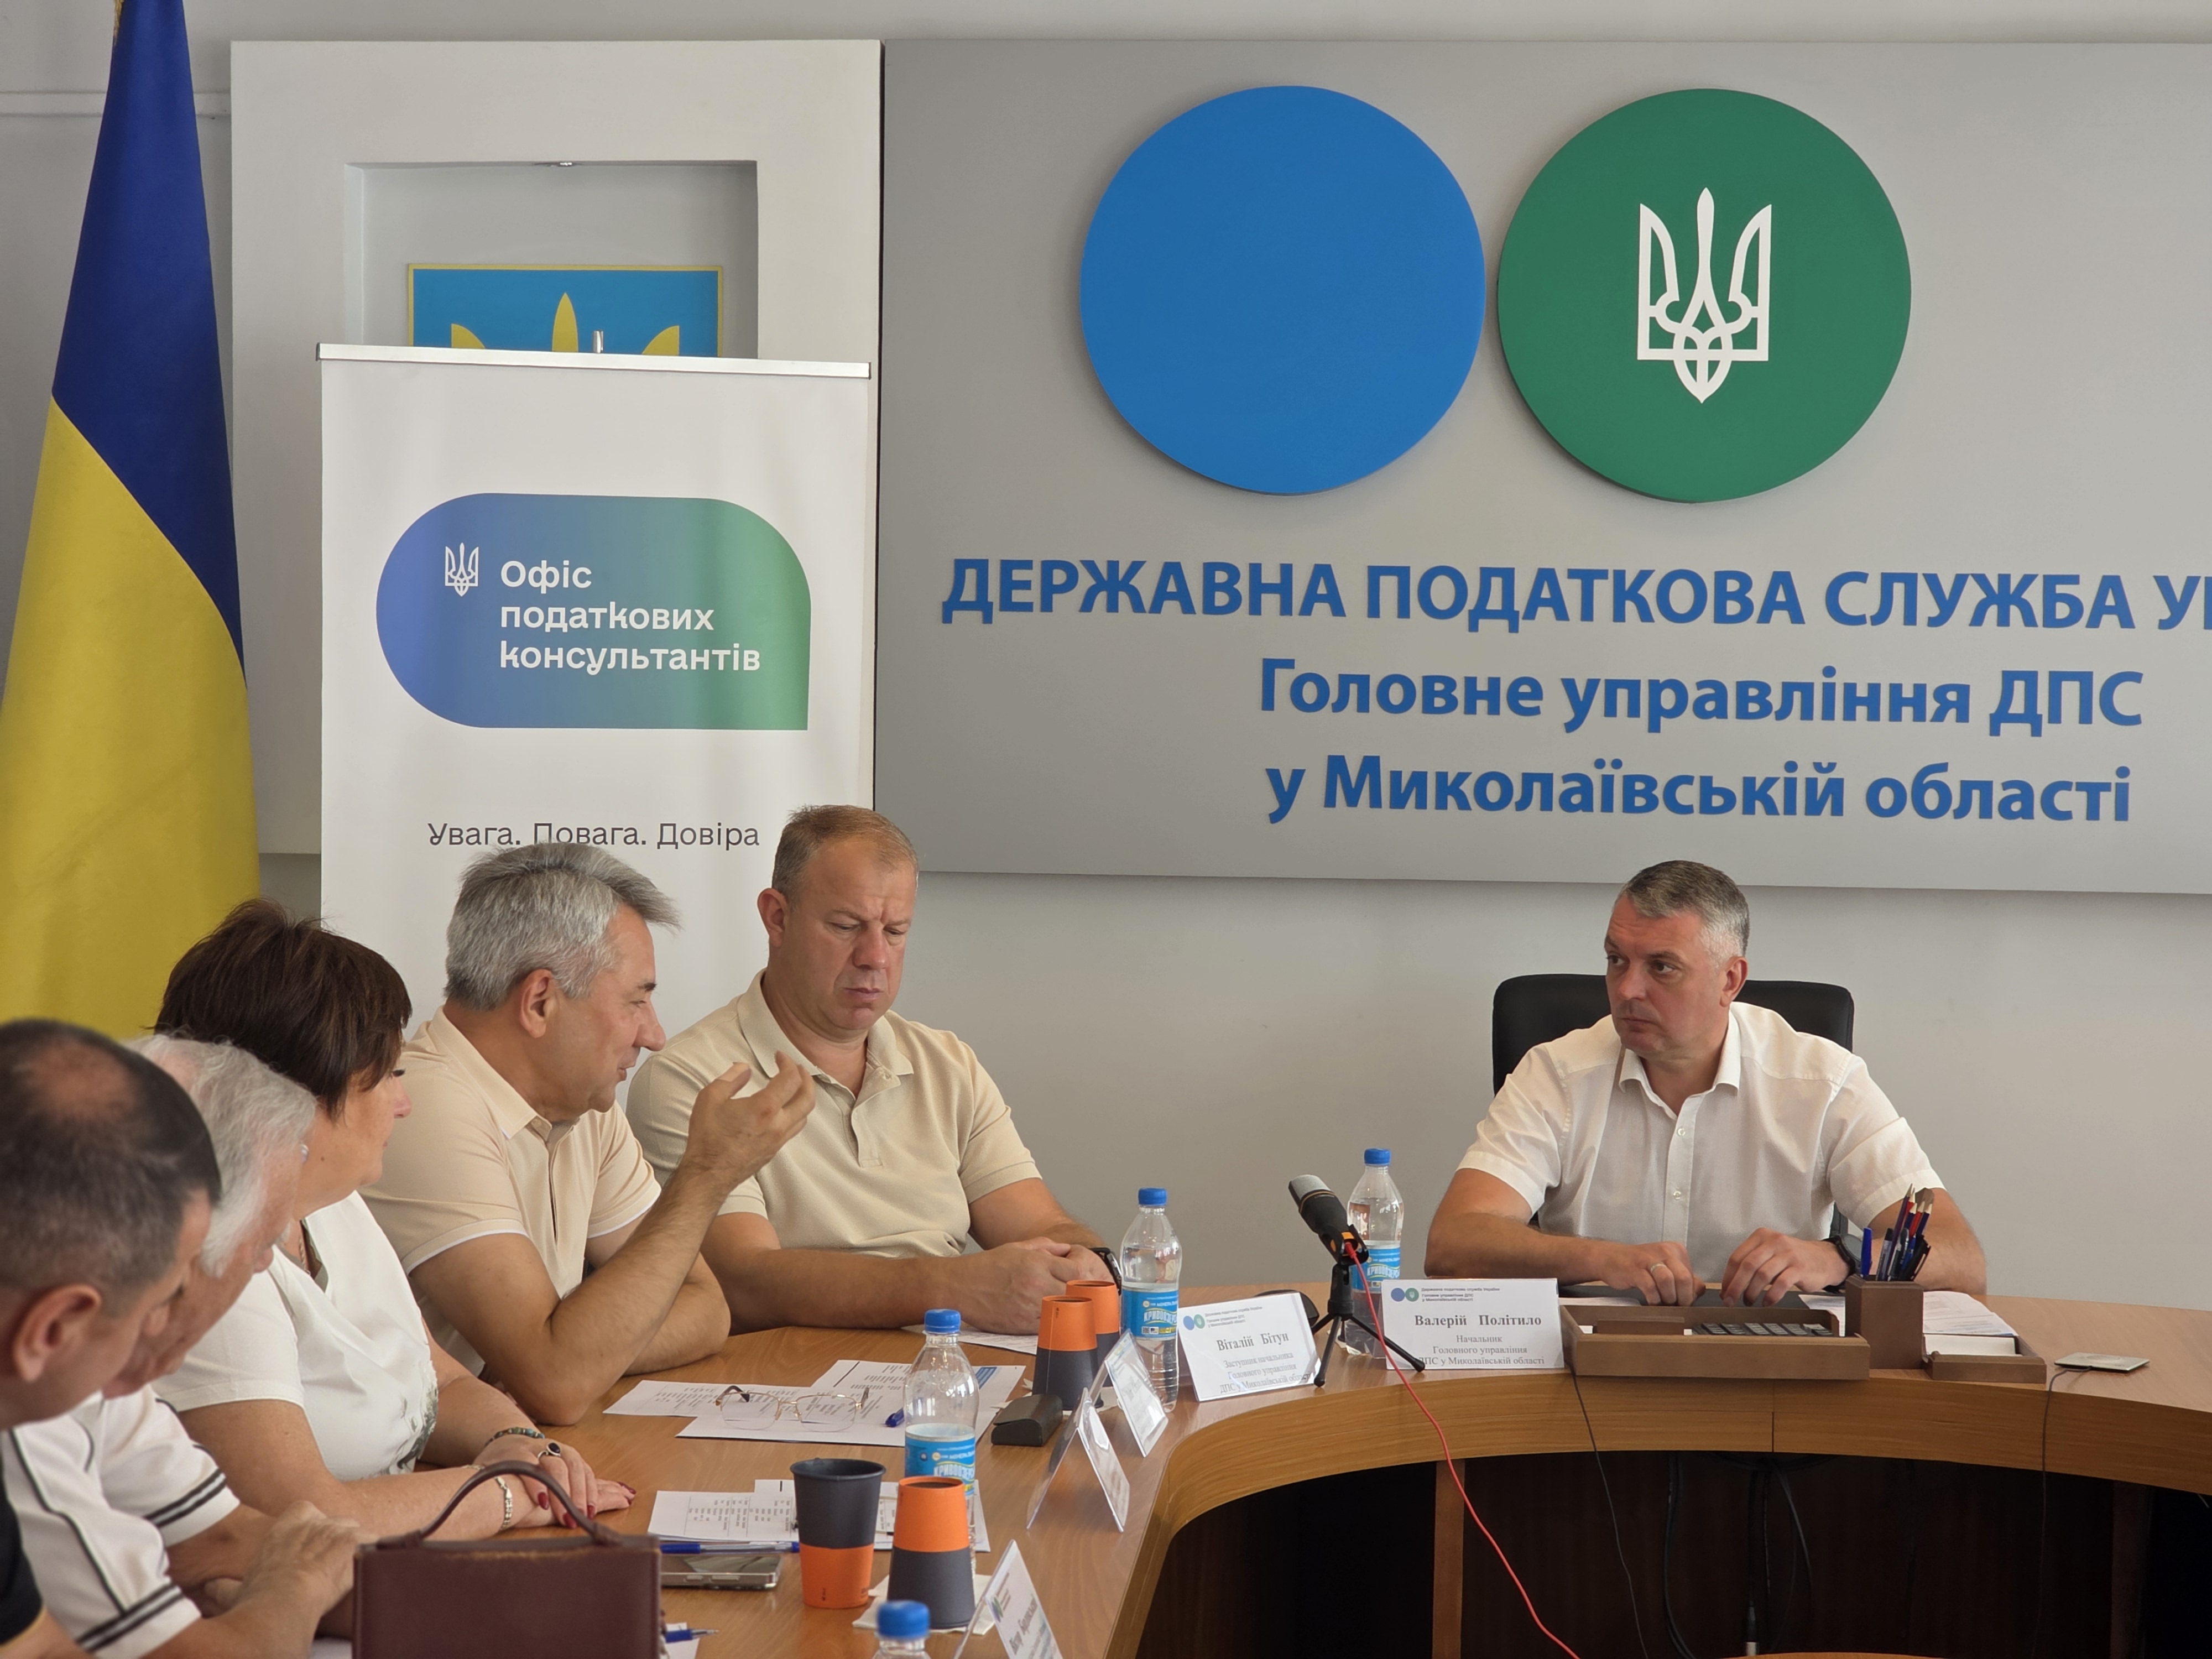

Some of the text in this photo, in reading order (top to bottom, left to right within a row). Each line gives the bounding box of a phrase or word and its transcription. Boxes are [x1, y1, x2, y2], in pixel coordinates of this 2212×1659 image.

[500, 559, 592, 594] Офіс
[942, 558, 2212, 633] ДЕРЖАВНА ПОДАТКОВА СЛУЖБА У
[500, 601, 714, 633] податкових
[500, 640, 761, 676] консультантів
[1262, 658, 2143, 738] Головне управління ДПС
[1266, 754, 2129, 823] у Миколаївській області
[427, 822, 760, 852] Увага. Повага. Довіра
[1414, 1314, 1542, 1328] Валерій Політило
[1216, 1336, 1255, 1351] Віталій
[1433, 1345, 1528, 1356] Головного управління
[1456, 1334, 1503, 1343] Начальник
[1448, 1357, 1511, 1365] Миколаївській
[1513, 1356, 1545, 1365] області
